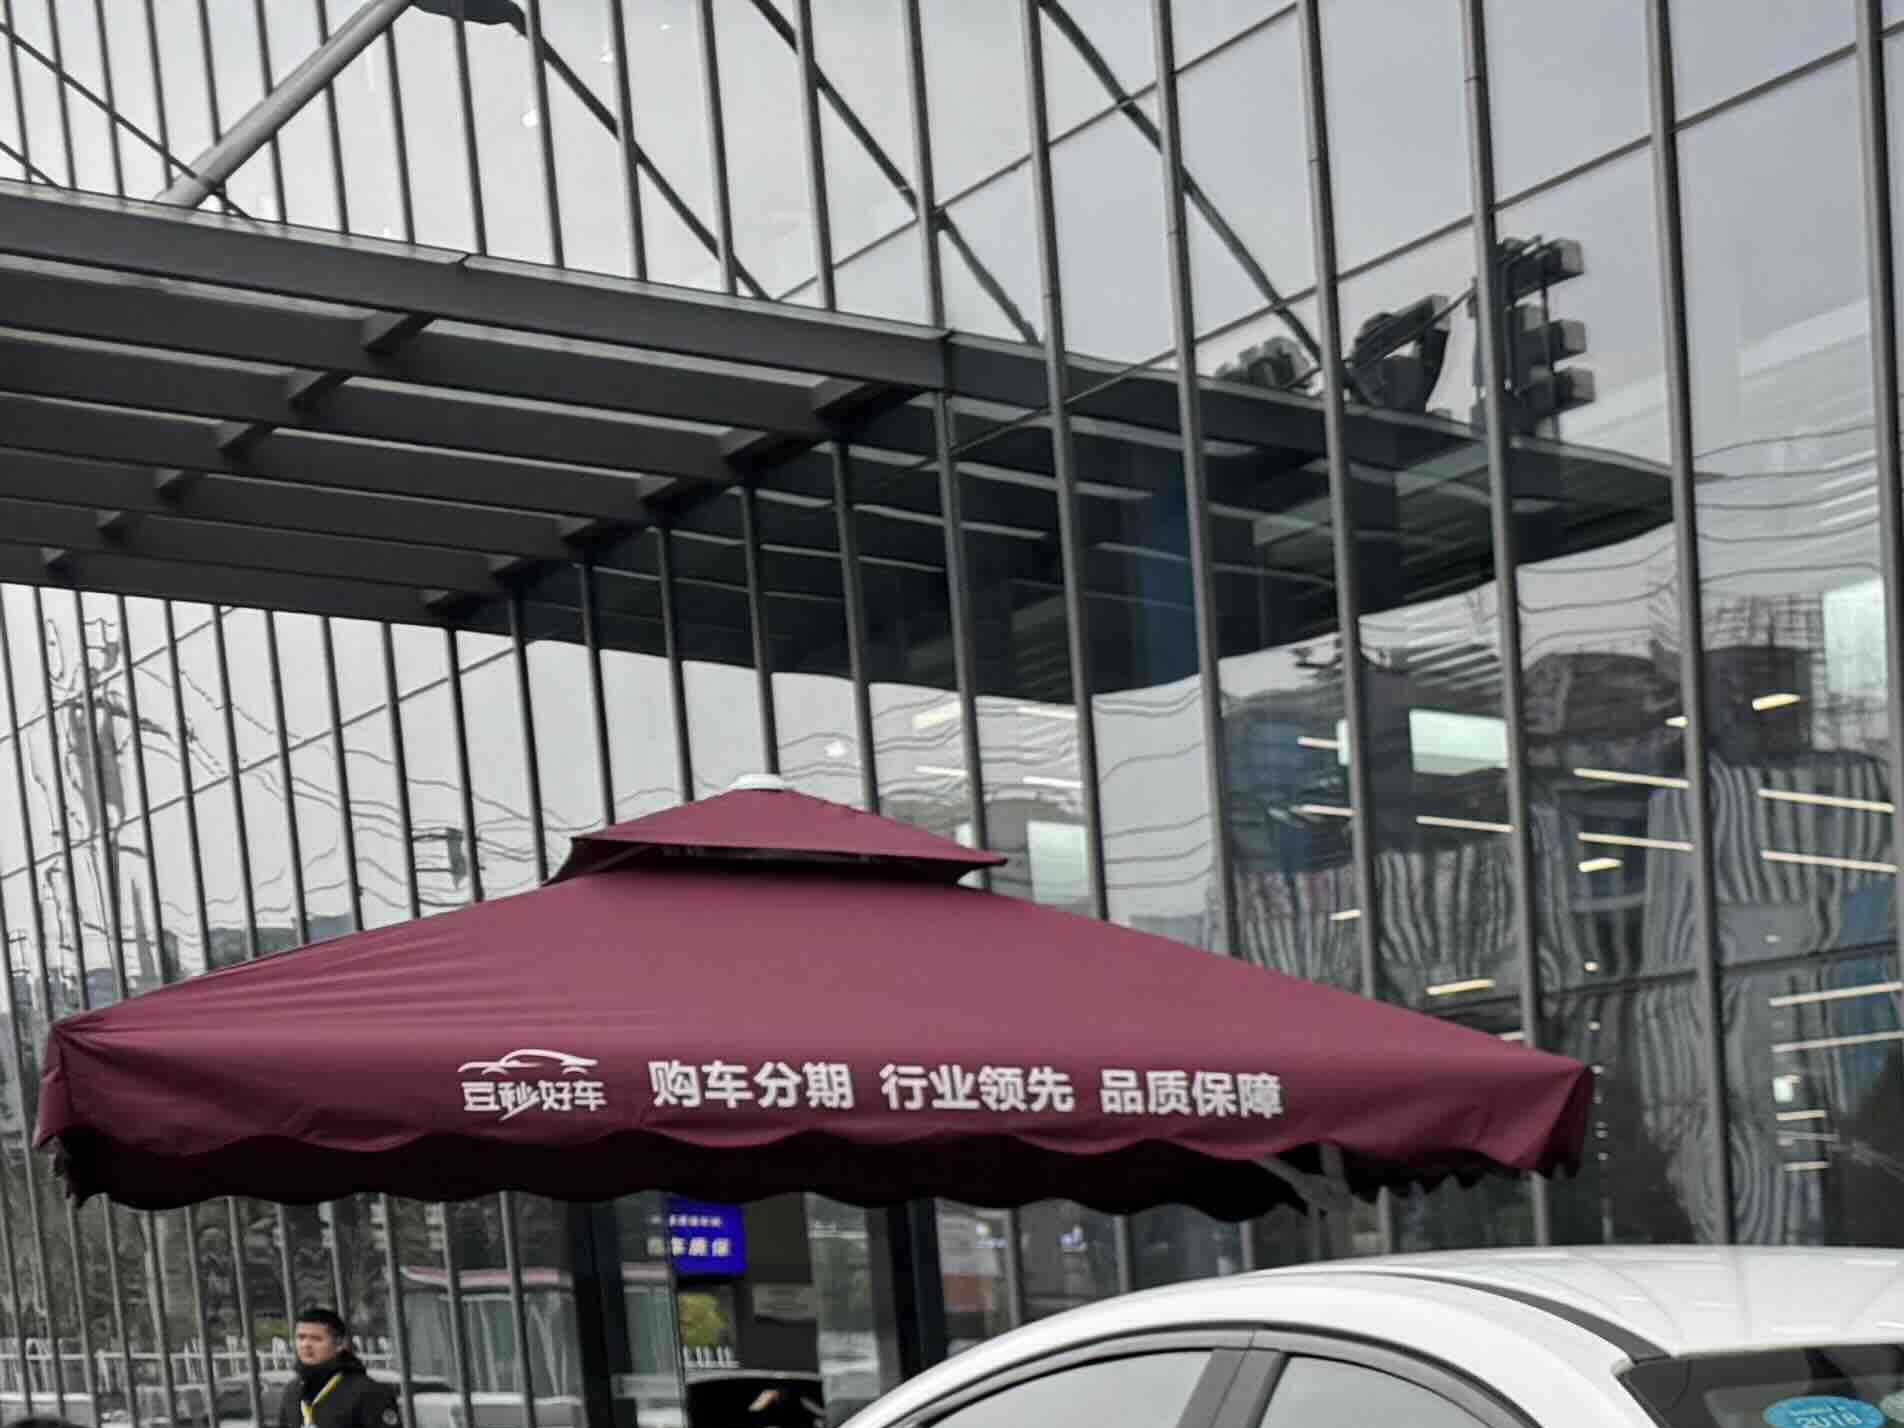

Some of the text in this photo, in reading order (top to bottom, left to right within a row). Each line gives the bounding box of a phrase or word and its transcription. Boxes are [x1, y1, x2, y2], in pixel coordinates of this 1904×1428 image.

[648, 1059, 855, 1110] 购车分期
[880, 1062, 1075, 1112] 行业领先
[1100, 1068, 1284, 1120] 品质保障
